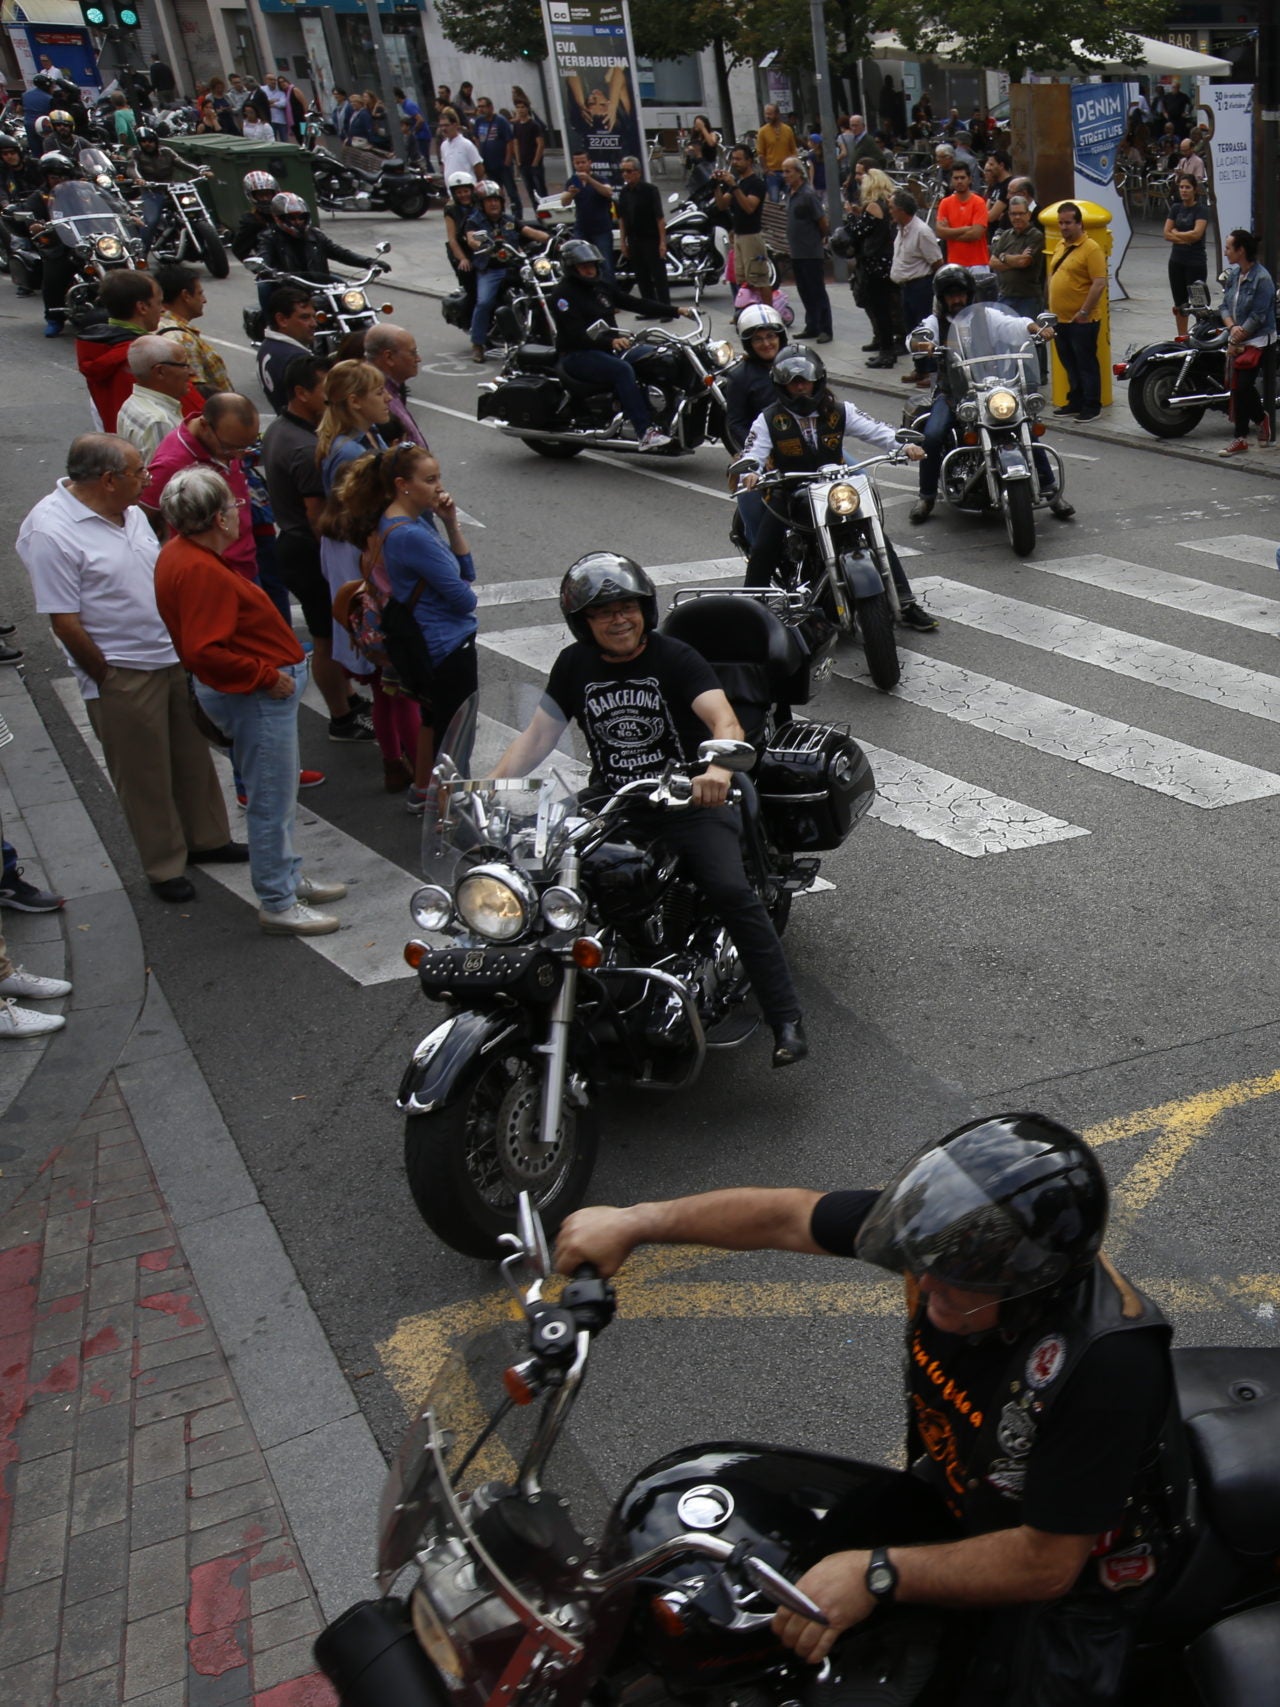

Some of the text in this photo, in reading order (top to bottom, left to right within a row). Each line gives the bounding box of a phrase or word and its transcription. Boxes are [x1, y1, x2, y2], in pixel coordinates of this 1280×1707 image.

[1168, 33, 1192, 49] BAR
[556, 42, 577, 53] EVA
[557, 56, 629, 67] YERBABUENA
[1076, 94, 1121, 124] DENIM
[1080, 123, 1123, 146] STREET LIFE
[589, 137, 619, 147] 22/OCT
[1217, 142, 1248, 153] TERRASSA
[588, 689, 661, 718] BARCELONA
[619, 721, 637, 731] Old
[609, 748, 665, 771] Capital
[466, 959, 480, 969] 66
